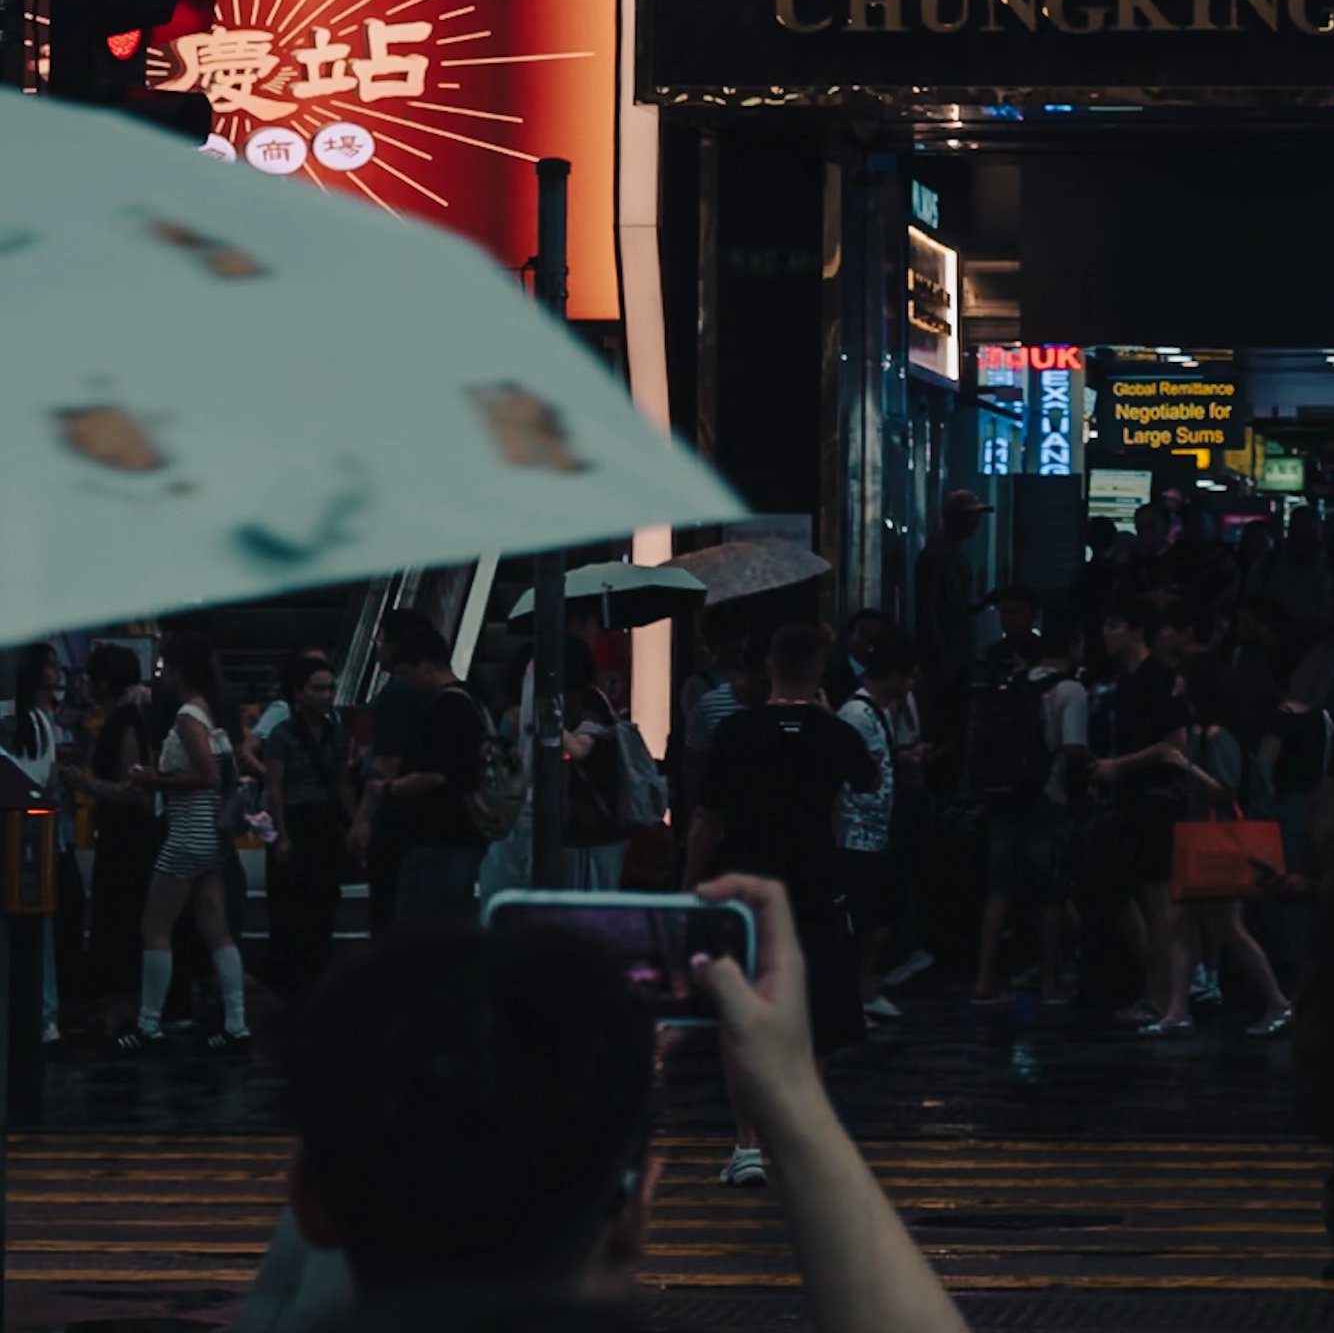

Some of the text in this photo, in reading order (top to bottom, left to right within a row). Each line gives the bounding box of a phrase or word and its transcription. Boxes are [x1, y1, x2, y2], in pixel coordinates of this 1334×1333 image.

[1112, 381, 1235, 397] Global Remittance
[1114, 402, 1233, 425] Negotiable for
[1123, 426, 1225, 449] Large Sums
